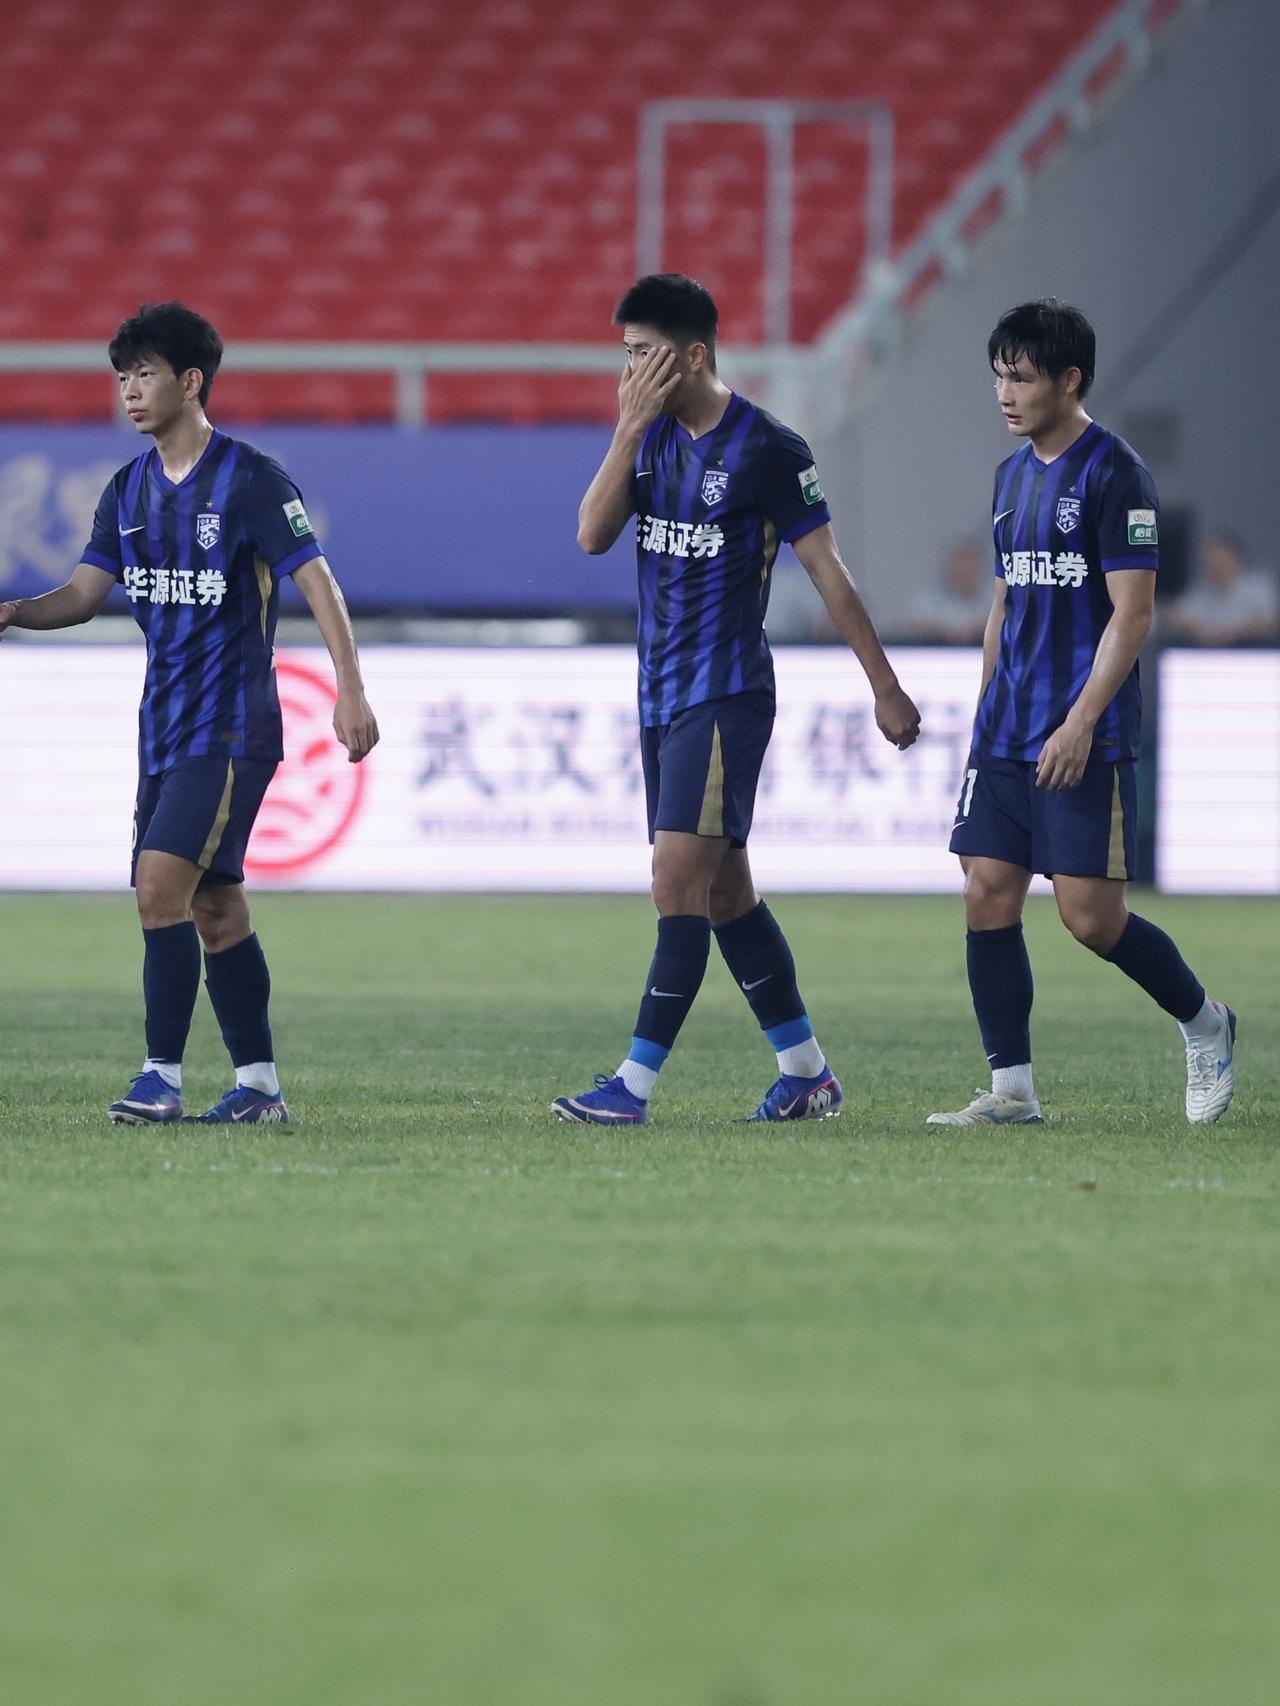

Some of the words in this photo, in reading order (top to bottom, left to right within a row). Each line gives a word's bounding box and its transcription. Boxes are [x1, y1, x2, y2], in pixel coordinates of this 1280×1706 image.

[123, 566, 228, 606] 华源证券
[956, 768, 978, 817] 1
